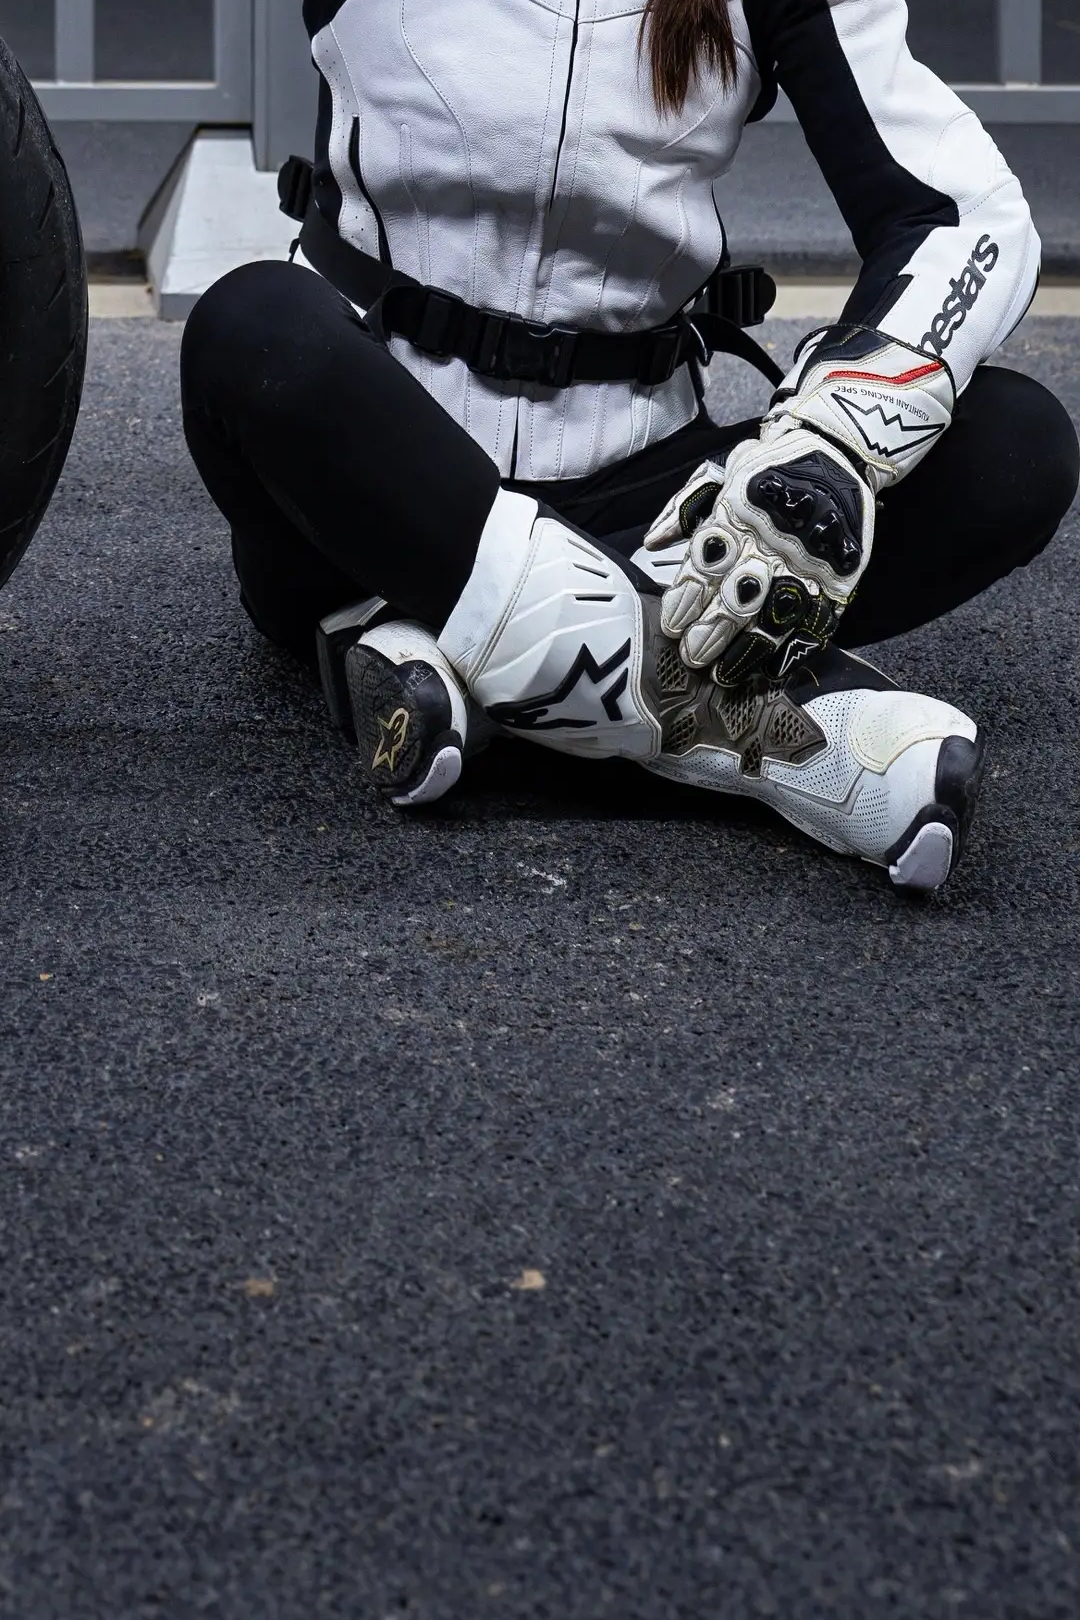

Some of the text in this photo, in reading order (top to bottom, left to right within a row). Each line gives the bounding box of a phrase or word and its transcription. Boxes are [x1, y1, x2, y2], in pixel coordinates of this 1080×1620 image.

[834, 385, 930, 422] KUSHITANI RACING SPEC
